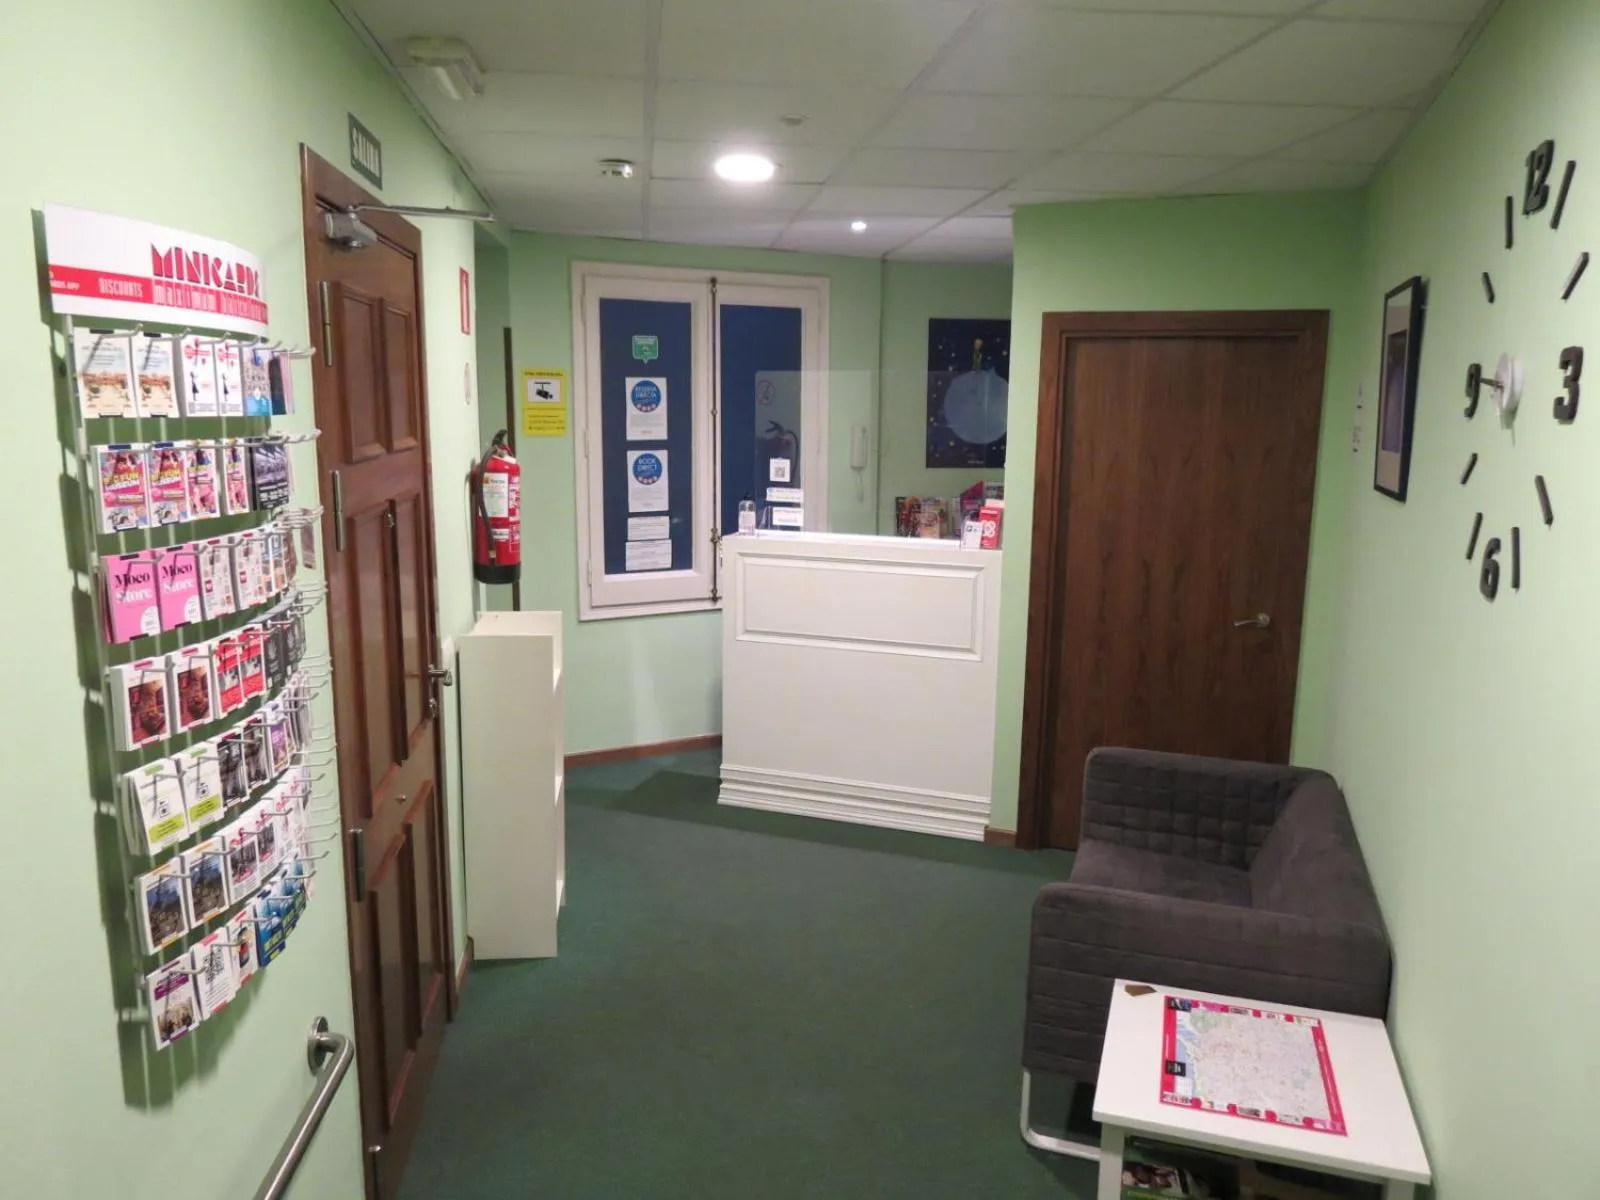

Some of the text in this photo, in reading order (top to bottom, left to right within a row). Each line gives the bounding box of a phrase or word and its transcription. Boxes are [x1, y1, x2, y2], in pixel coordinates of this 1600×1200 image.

[352, 126, 380, 178] SALIDA
[1522, 138, 1554, 216] 12
[150, 243, 258, 298] MINICARDS
[98, 278, 144, 296] DISCOUNTS
[1464, 363, 1482, 419] 9
[1553, 346, 1583, 425] 3
[637, 464, 658, 473] DIRECT
[638, 457, 657, 465] BOOK
[161, 563, 193, 579] Moco
[1479, 537, 1501, 602] 6
[114, 573, 150, 588] Moco
[163, 579, 194, 594] Store
[115, 588, 153, 604] Store
